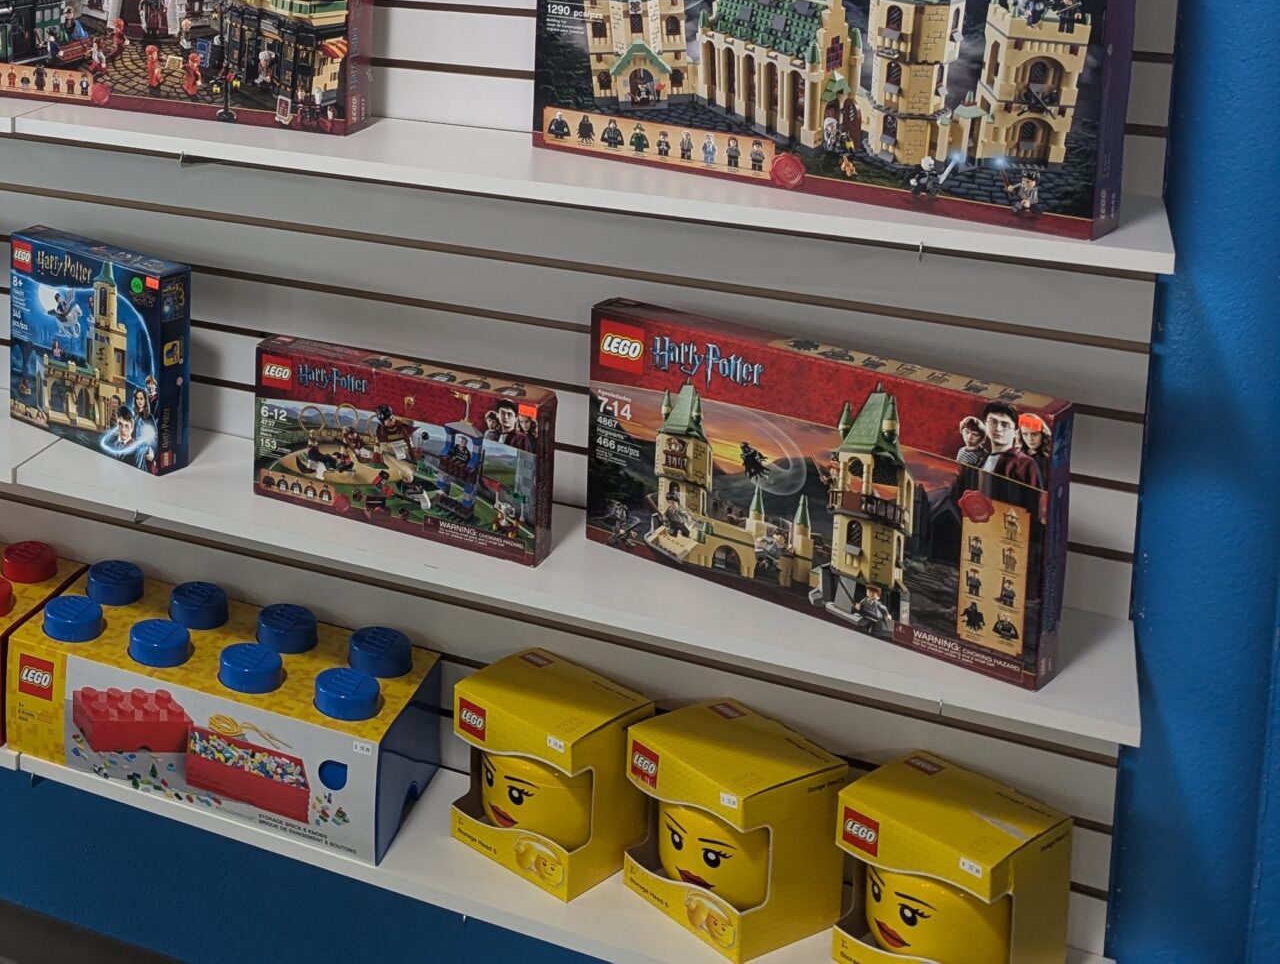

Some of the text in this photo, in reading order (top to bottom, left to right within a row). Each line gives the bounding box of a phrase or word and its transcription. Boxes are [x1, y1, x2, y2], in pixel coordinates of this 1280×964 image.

[547, 3, 603, 19] 1290 pcs/pzs
[13, 247, 31, 263] LEGO
[36, 250, 93, 284] Harry Potter
[12, 275, 24, 288] 8+
[601, 333, 643, 360] LEGO
[263, 364, 292, 381] LEGO
[651, 336, 764, 392] Harry Potter
[298, 364, 368, 393] Harry Potter
[260, 405, 287, 422] 6-12
[598, 396, 632, 421] 7-14
[597, 415, 618, 428] 4867
[260, 438, 277, 449] 153
[596, 436, 640, 457] 466 pcs/pzs
[439, 520, 478, 536] WARNING:
[912, 629, 961, 652] WARNING:
[962, 648, 993, 663] CHOKING
[21, 666, 51, 687] LEGO
[461, 707, 484, 730] LEGO
[633, 751, 657, 776] LEGO
[258, 813, 283, 825] STORAGE
[284, 820, 302, 831] BRICK
[308, 828, 328, 839] KNOBS
[258, 819, 280, 831] BRIQUE
[289, 828, 323, 844] RANGEMENT
[330, 840, 357, 854] BOUTONS
[845, 818, 877, 845] LEGO
[457, 827, 478, 843] Storage
[477, 840, 492, 852] Head
[629, 877, 650, 894] Storage
